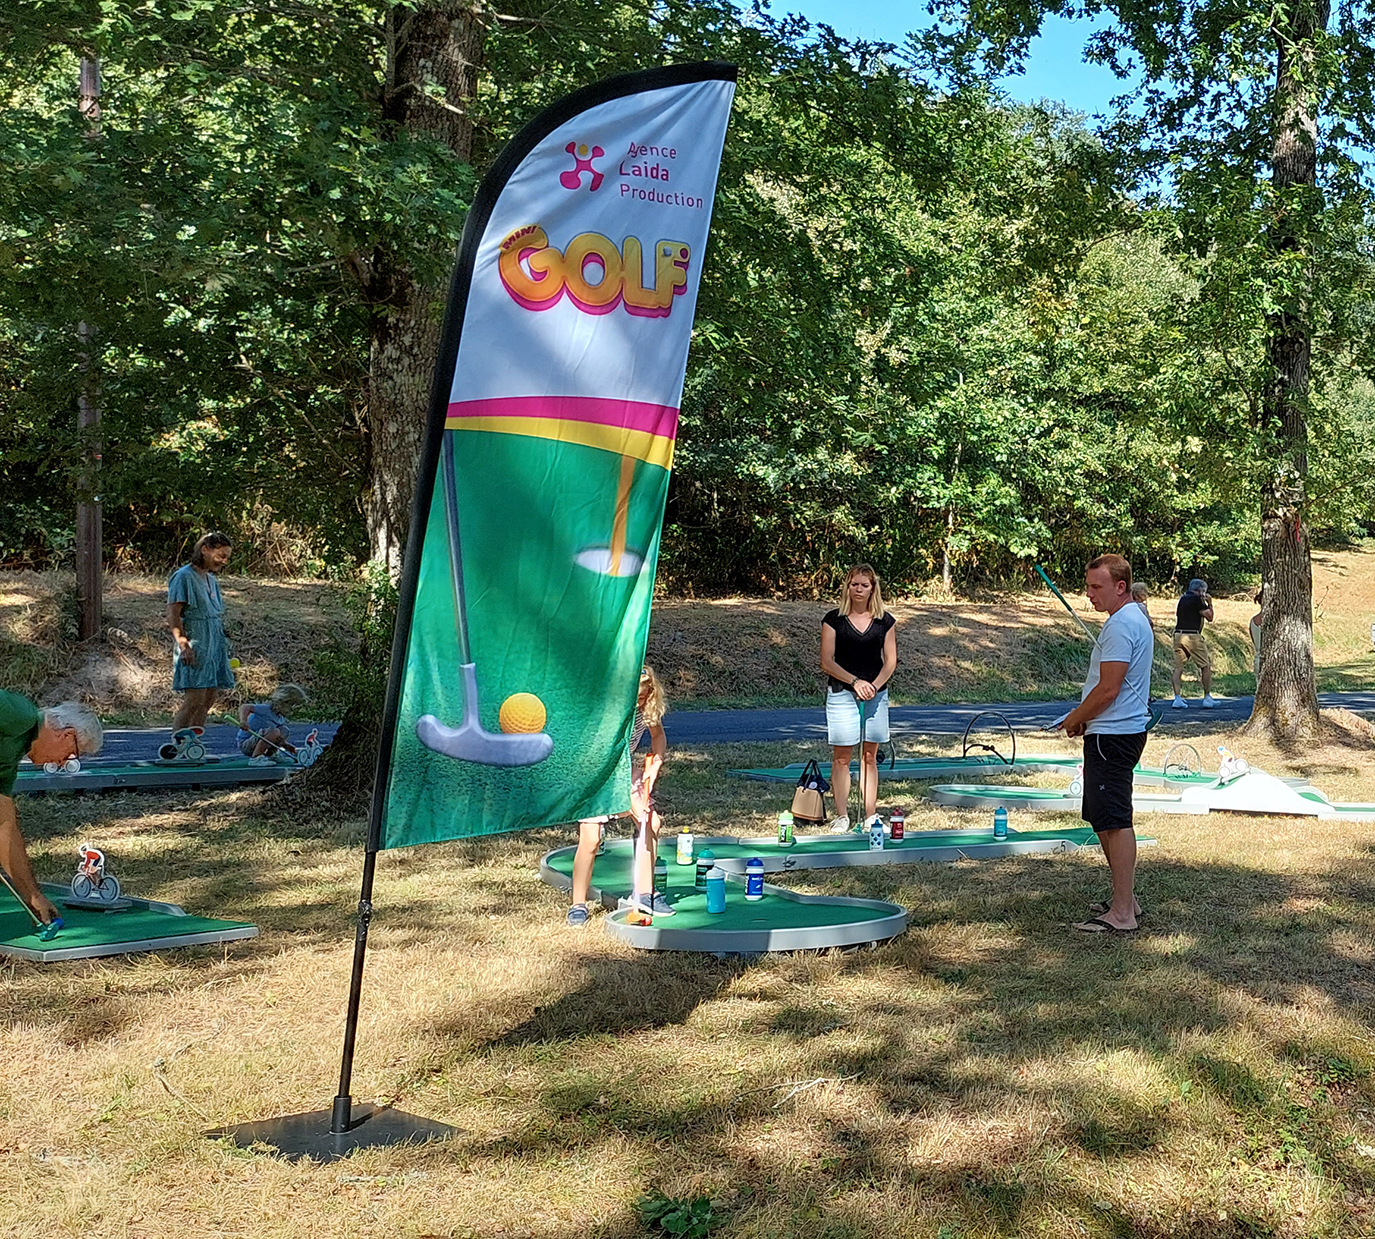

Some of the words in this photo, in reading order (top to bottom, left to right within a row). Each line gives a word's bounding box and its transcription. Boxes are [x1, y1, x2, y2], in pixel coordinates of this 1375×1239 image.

[627, 142, 677, 159] Agence
[619, 160, 669, 182] Laida
[620, 183, 703, 209] Production
[502, 225, 537, 250] MINI
[498, 223, 691, 319] GOLF
